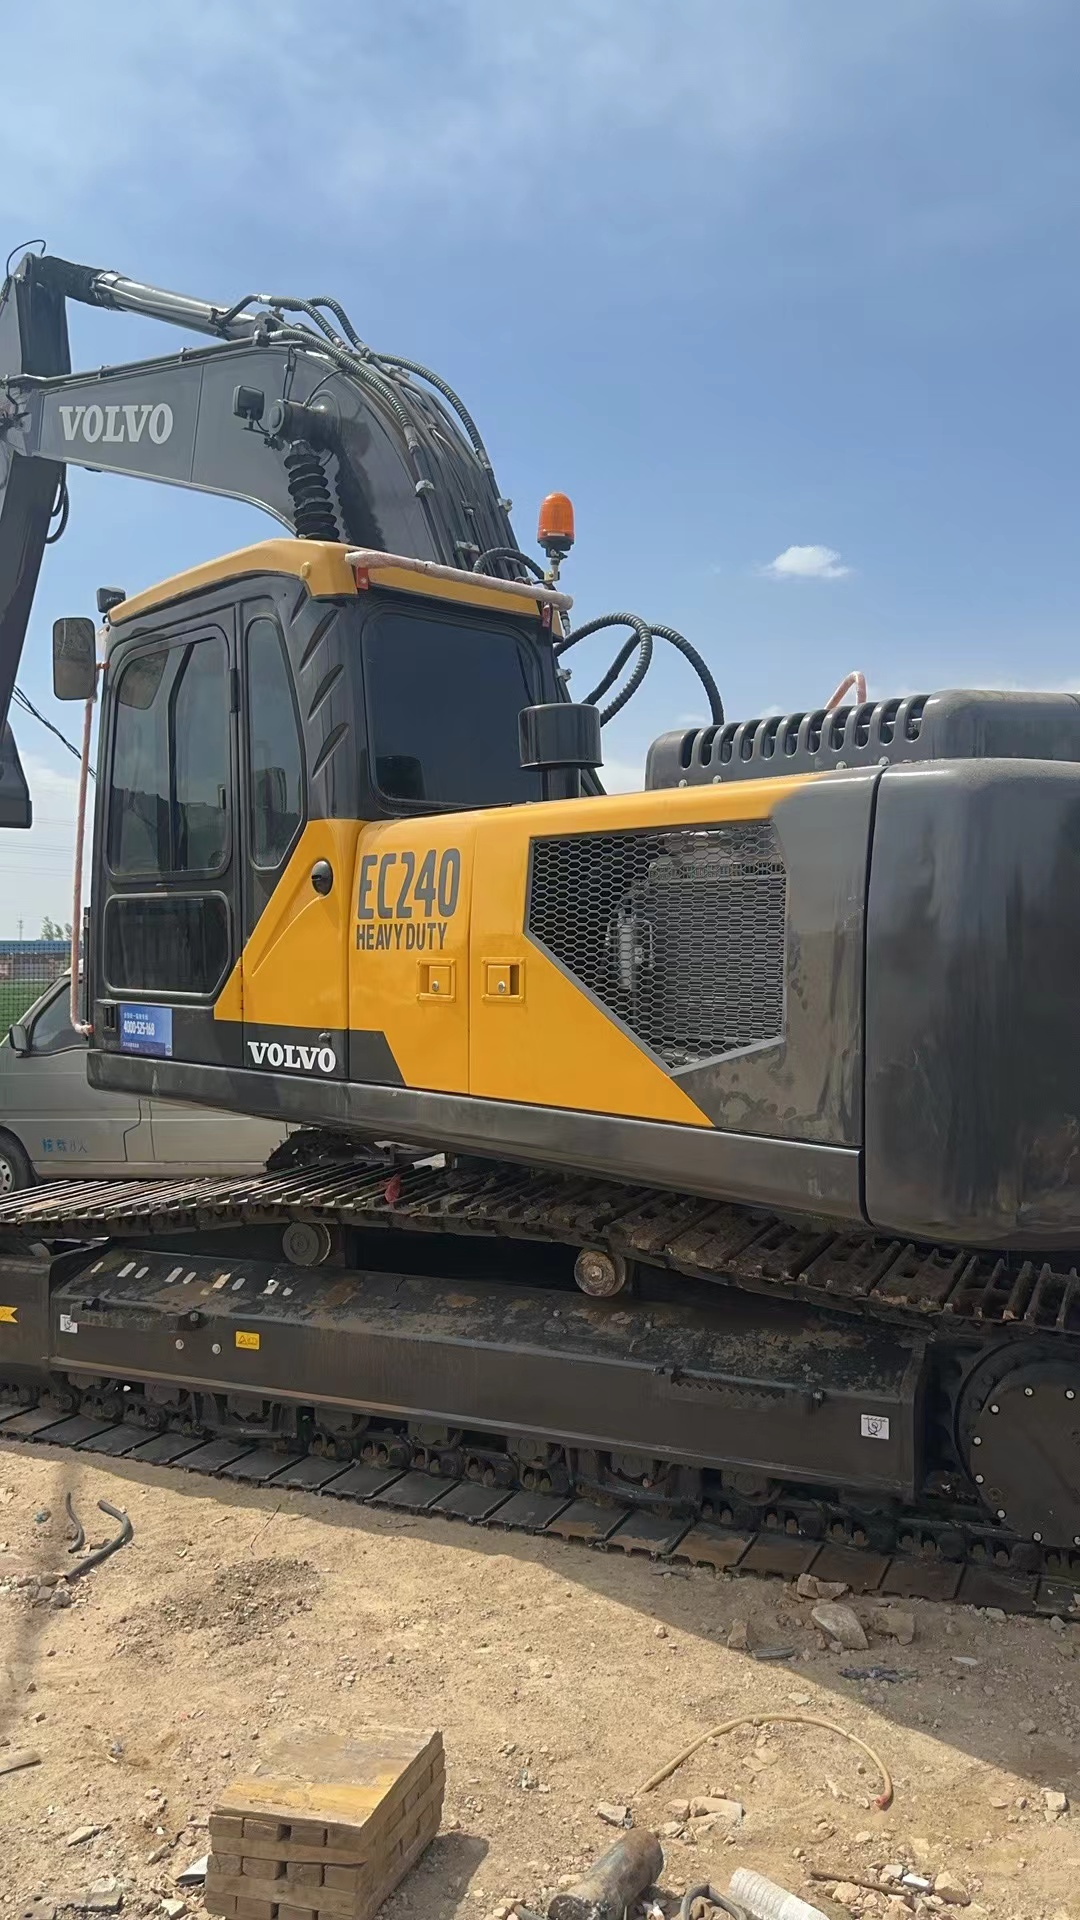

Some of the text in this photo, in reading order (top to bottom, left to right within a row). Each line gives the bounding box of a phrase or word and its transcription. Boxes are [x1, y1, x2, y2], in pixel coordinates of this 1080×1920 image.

[59, 403, 174, 445] VOLVO
[357, 847, 461, 919] EC240
[247, 1041, 337, 1073] VOLVO
